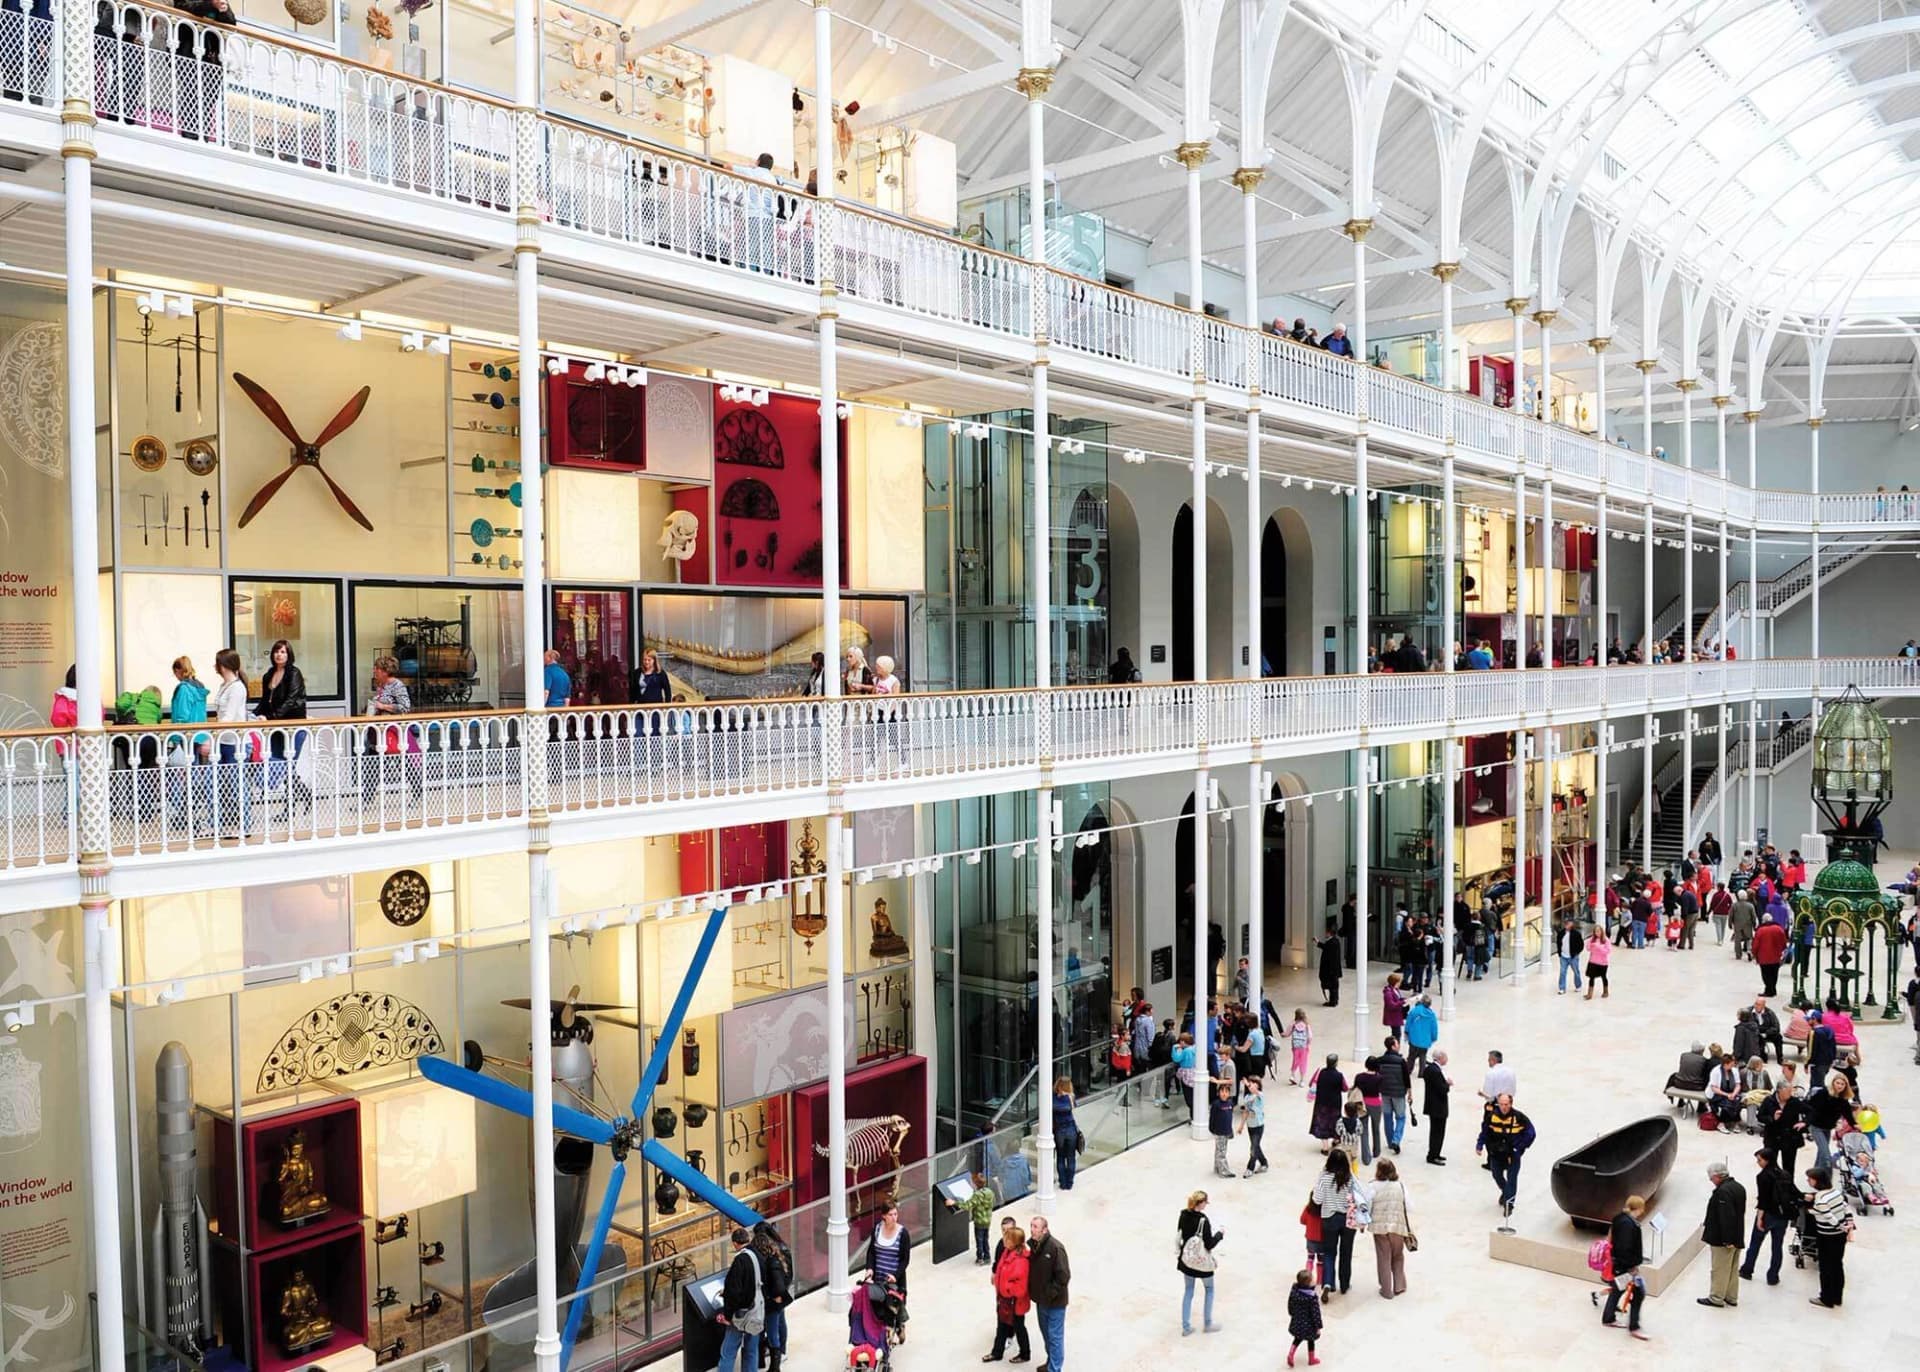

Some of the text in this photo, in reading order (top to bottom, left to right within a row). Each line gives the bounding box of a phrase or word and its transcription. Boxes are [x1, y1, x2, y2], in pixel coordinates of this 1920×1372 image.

[1073, 214, 1098, 280] 5
[1075, 524, 1102, 600] 3
[21, 585, 57, 597] world
[14, 1193, 37, 1205] the
[40, 1180, 72, 1200] world
